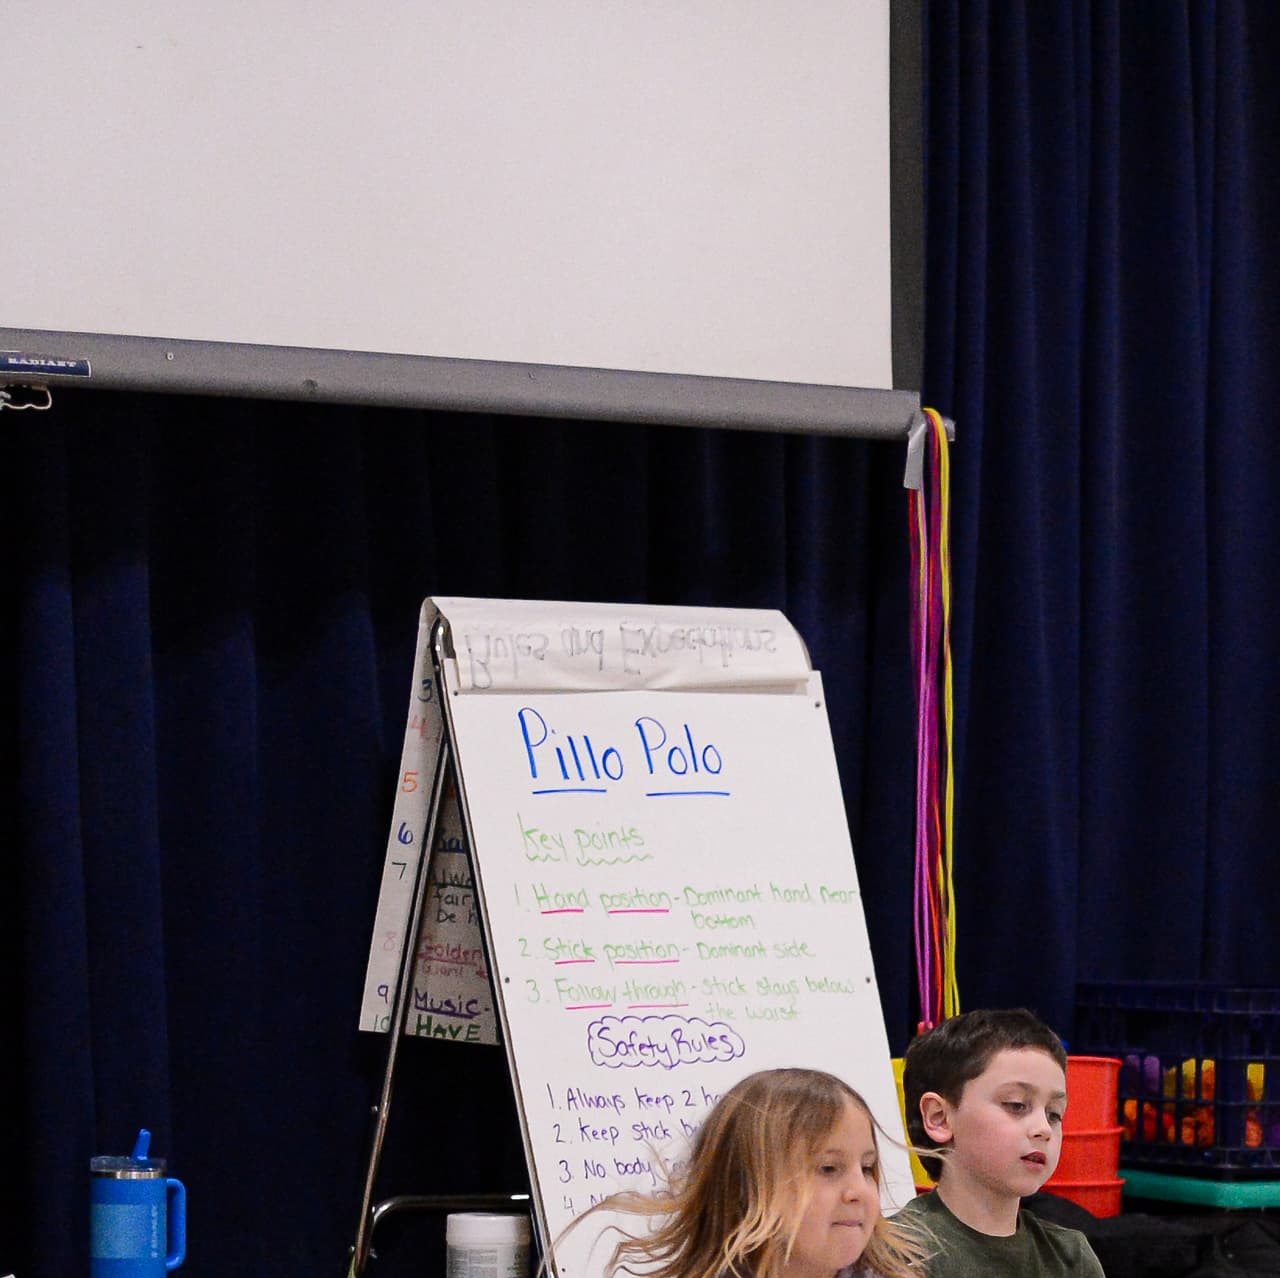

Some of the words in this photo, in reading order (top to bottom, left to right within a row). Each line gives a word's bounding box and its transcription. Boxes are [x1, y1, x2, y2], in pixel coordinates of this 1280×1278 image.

[518, 706, 624, 781] Pillo
[635, 716, 722, 775] Polo
[532, 882, 590, 909] Hand
[770, 881, 811, 905] hand
[691, 910, 755, 930] bottom
[773, 939, 816, 959] side
[553, 977, 617, 1003] Follow
[805, 976, 856, 994] below
[415, 1013, 481, 1042] HAVE
[596, 1026, 674, 1069] Safety
[671, 1027, 735, 1057] Rules
[566, 1087, 626, 1116] Always
[681, 1089, 697, 1107] 2
[584, 1158, 606, 1179] No
[613, 1157, 657, 1187] body
